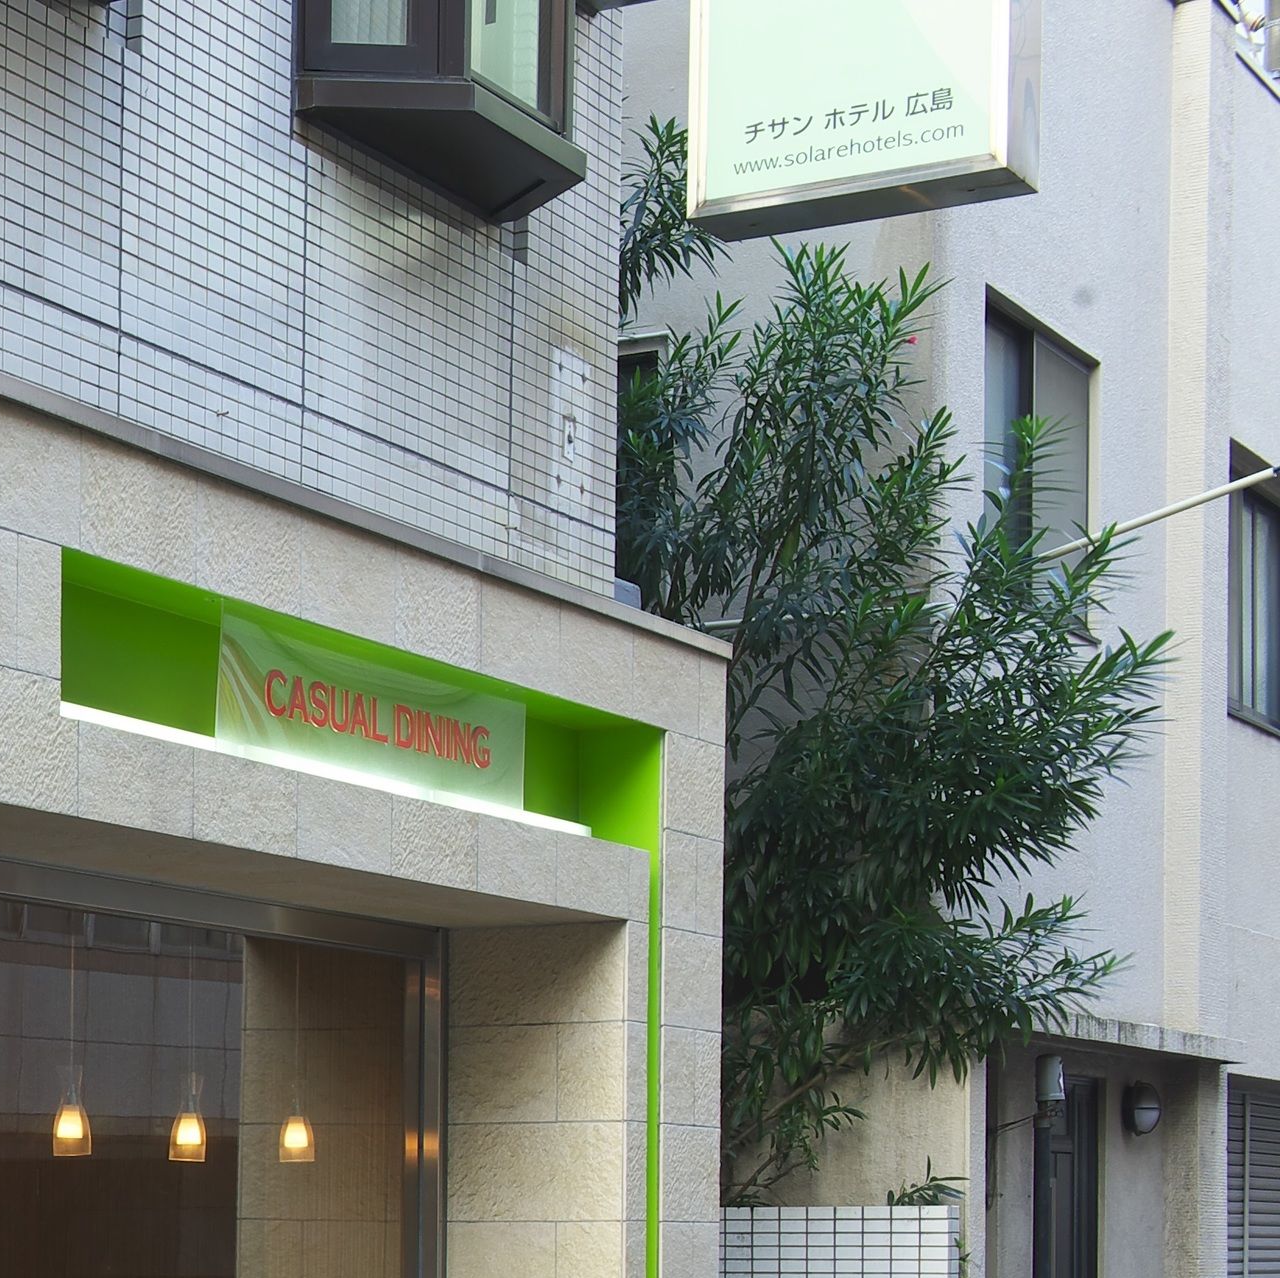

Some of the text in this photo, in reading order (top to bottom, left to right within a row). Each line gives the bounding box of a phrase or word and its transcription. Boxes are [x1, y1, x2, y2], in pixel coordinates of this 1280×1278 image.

[744, 87, 954, 144] チサン ホテル 広島
[733, 121, 965, 176] www.solarehotels.com
[264, 669, 492, 770] CASUAL DINING
